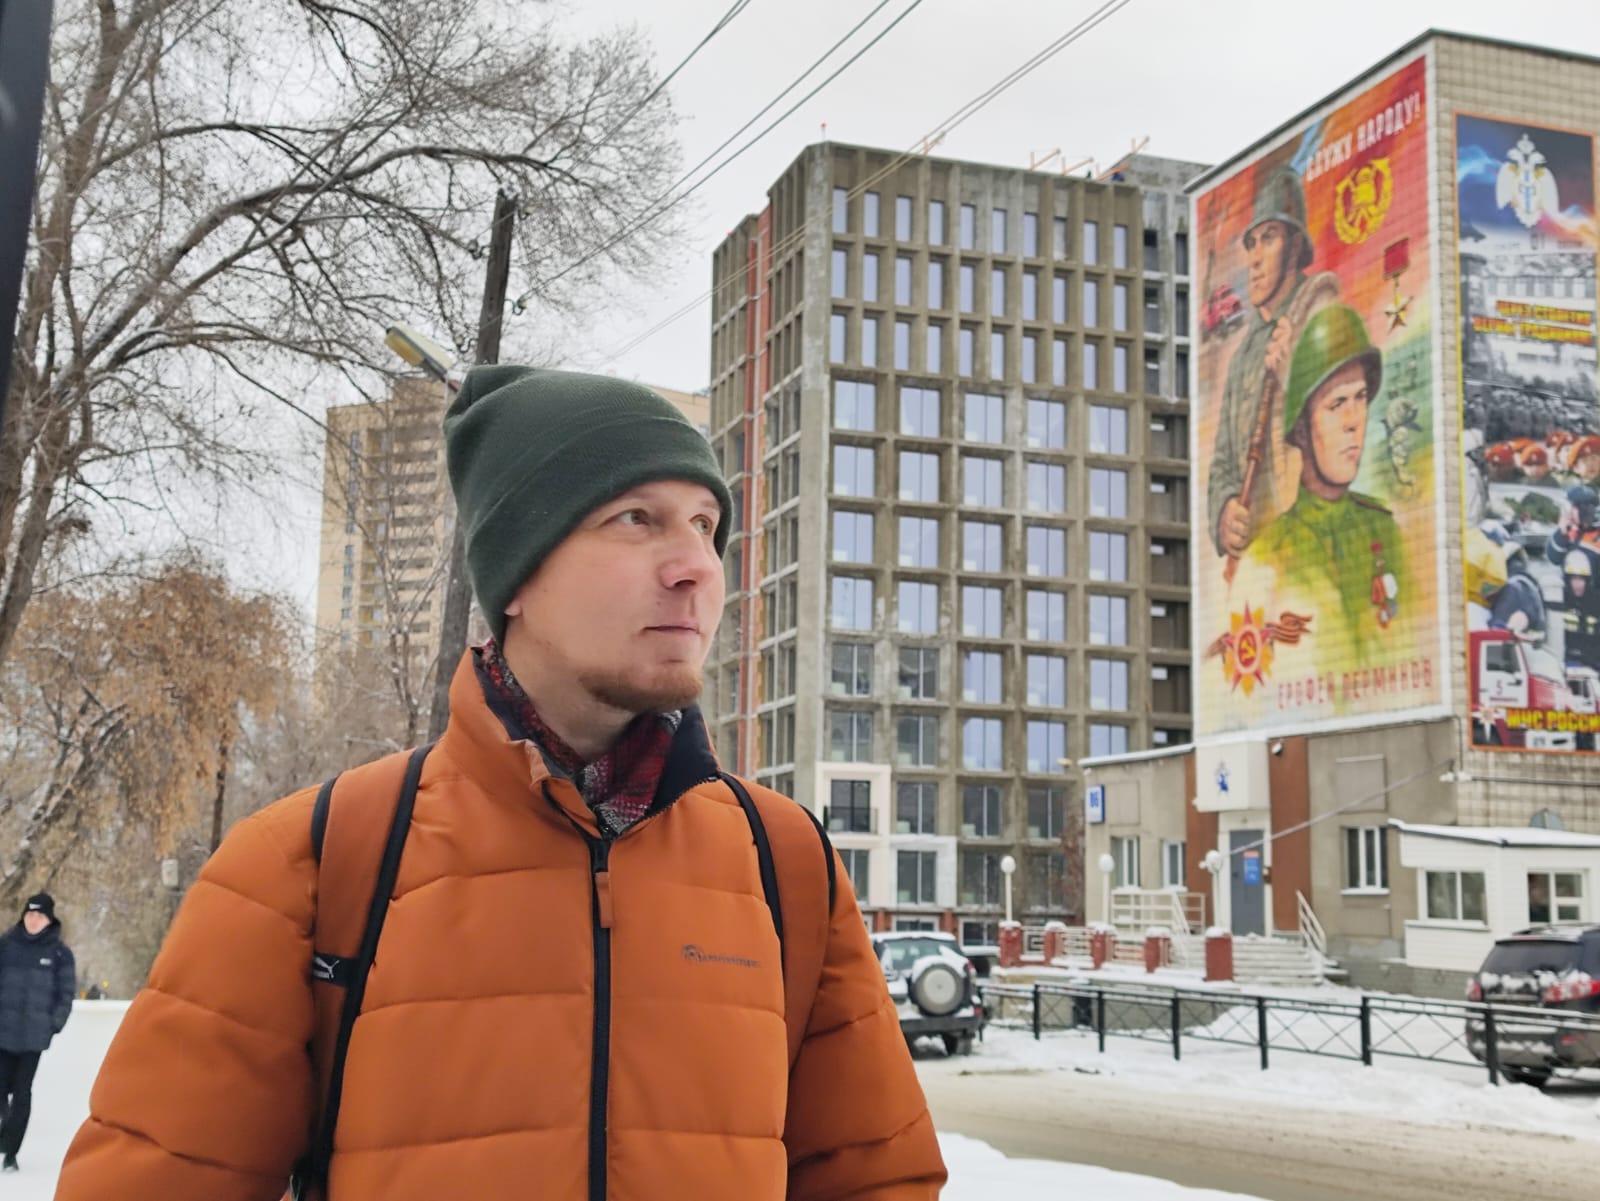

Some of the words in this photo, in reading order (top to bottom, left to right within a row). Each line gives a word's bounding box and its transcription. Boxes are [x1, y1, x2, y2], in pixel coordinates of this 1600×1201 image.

[1305, 132, 1352, 182] СЛУЖУ
[1357, 91, 1420, 153] НАРОДУ!
[1342, 658, 1433, 704] ПЕРМИНОВ
[1505, 708, 1544, 730] МЧС
